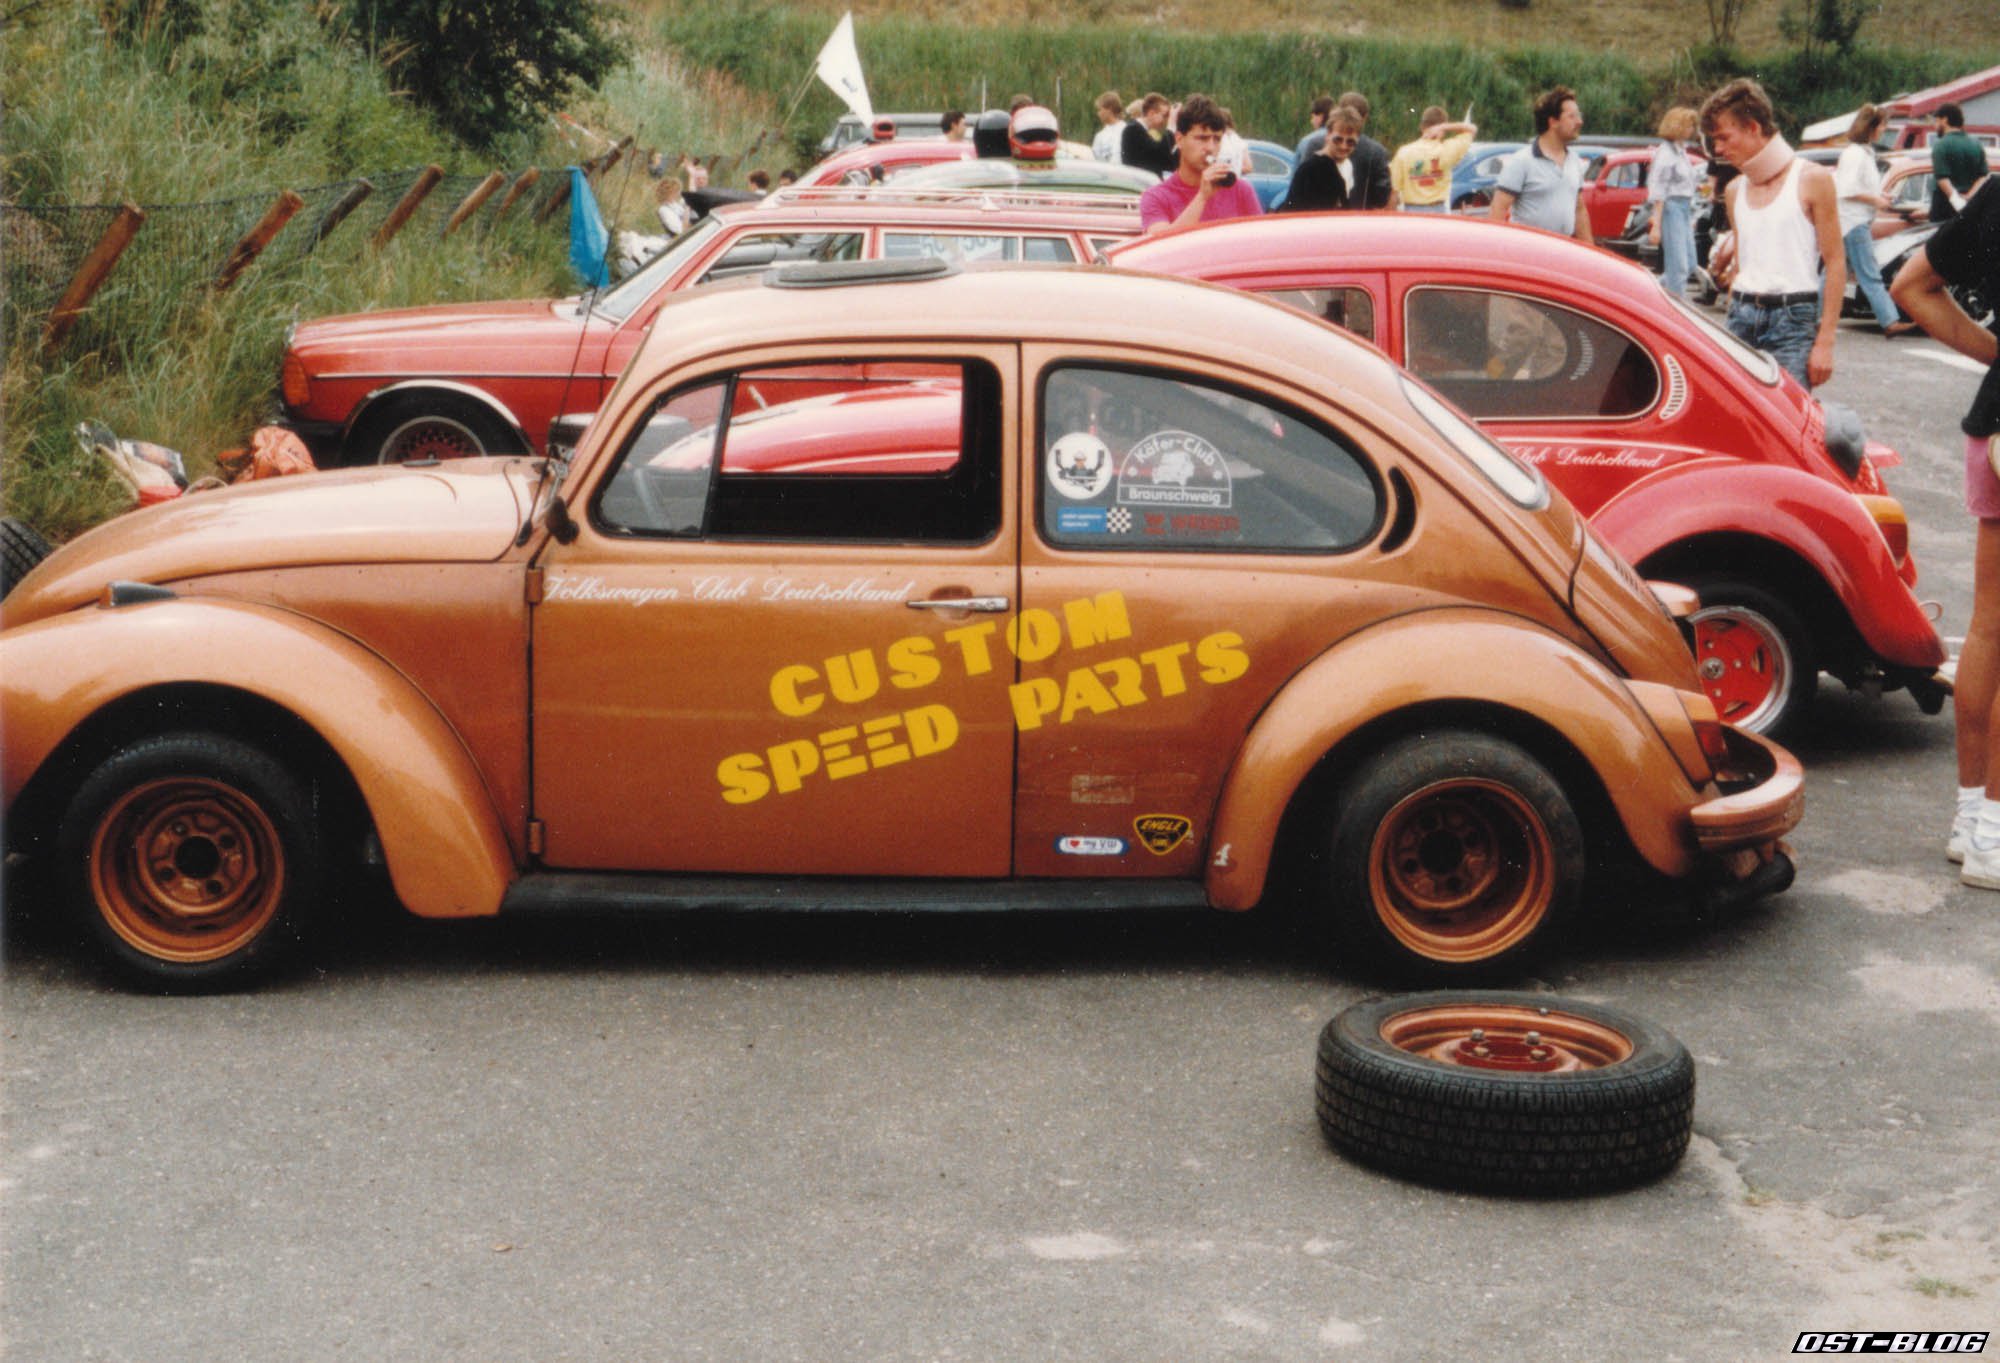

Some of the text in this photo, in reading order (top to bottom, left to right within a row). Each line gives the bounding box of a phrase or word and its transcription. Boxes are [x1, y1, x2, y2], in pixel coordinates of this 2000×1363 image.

[1555, 447, 1665, 468] Deutschland
[1128, 488, 1222, 507] Braunschweig
[543, 575, 916, 607] Volkswagen Club Deutschland
[769, 590, 1132, 718] CUSTOM
[716, 631, 1250, 805] SPEED PARTS
